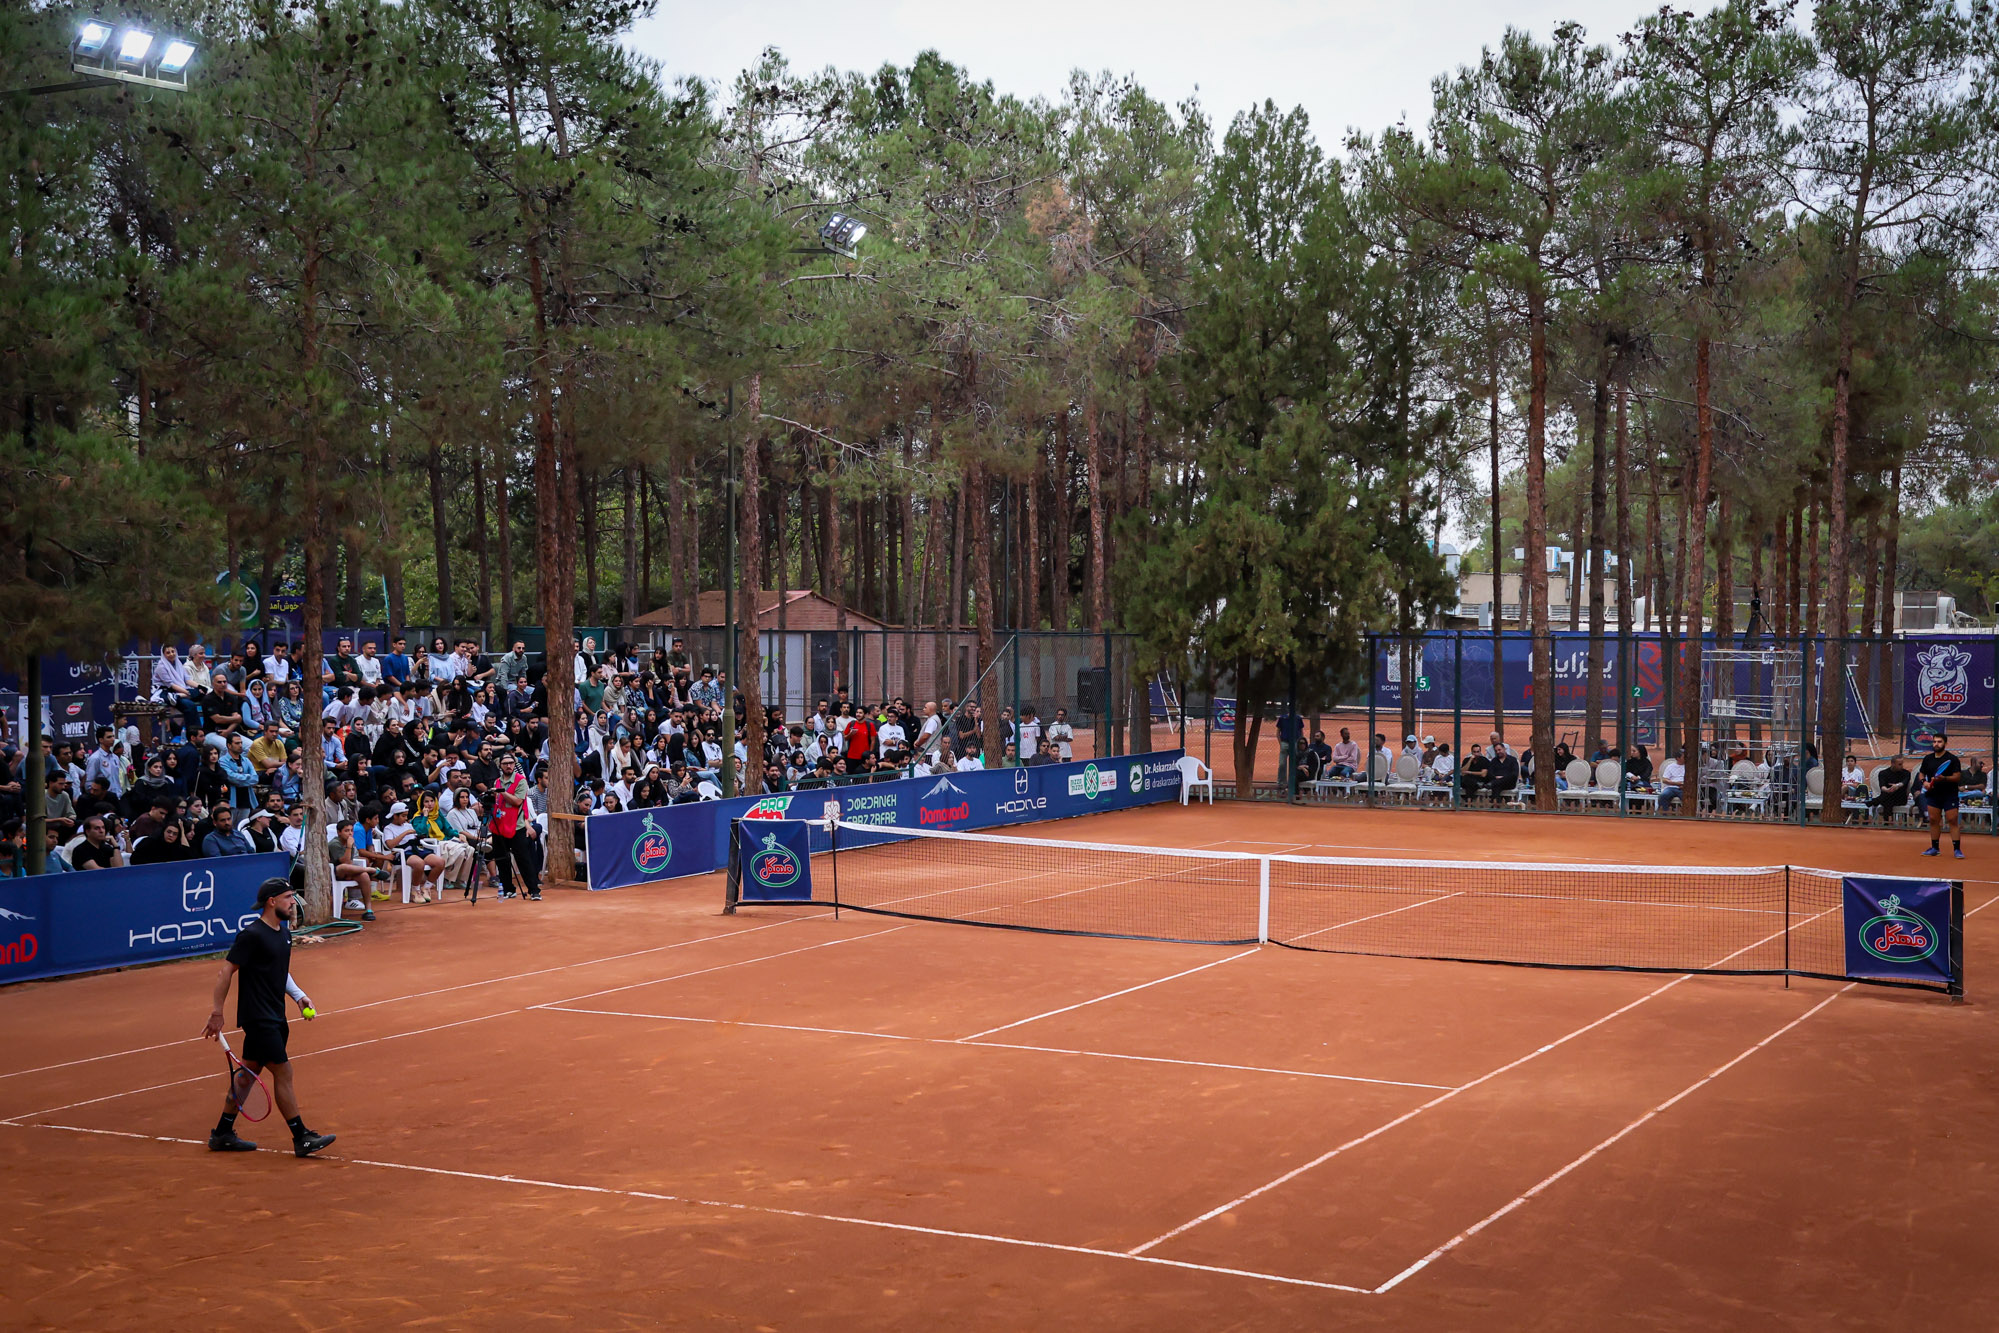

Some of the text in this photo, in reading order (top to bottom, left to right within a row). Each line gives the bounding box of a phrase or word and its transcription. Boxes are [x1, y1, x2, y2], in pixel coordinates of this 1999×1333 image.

[1419, 677, 1427, 688] 5
[1633, 687, 1641, 697] 2
[65, 721, 90, 735] WHEY
[760, 796, 789, 813] PRO
